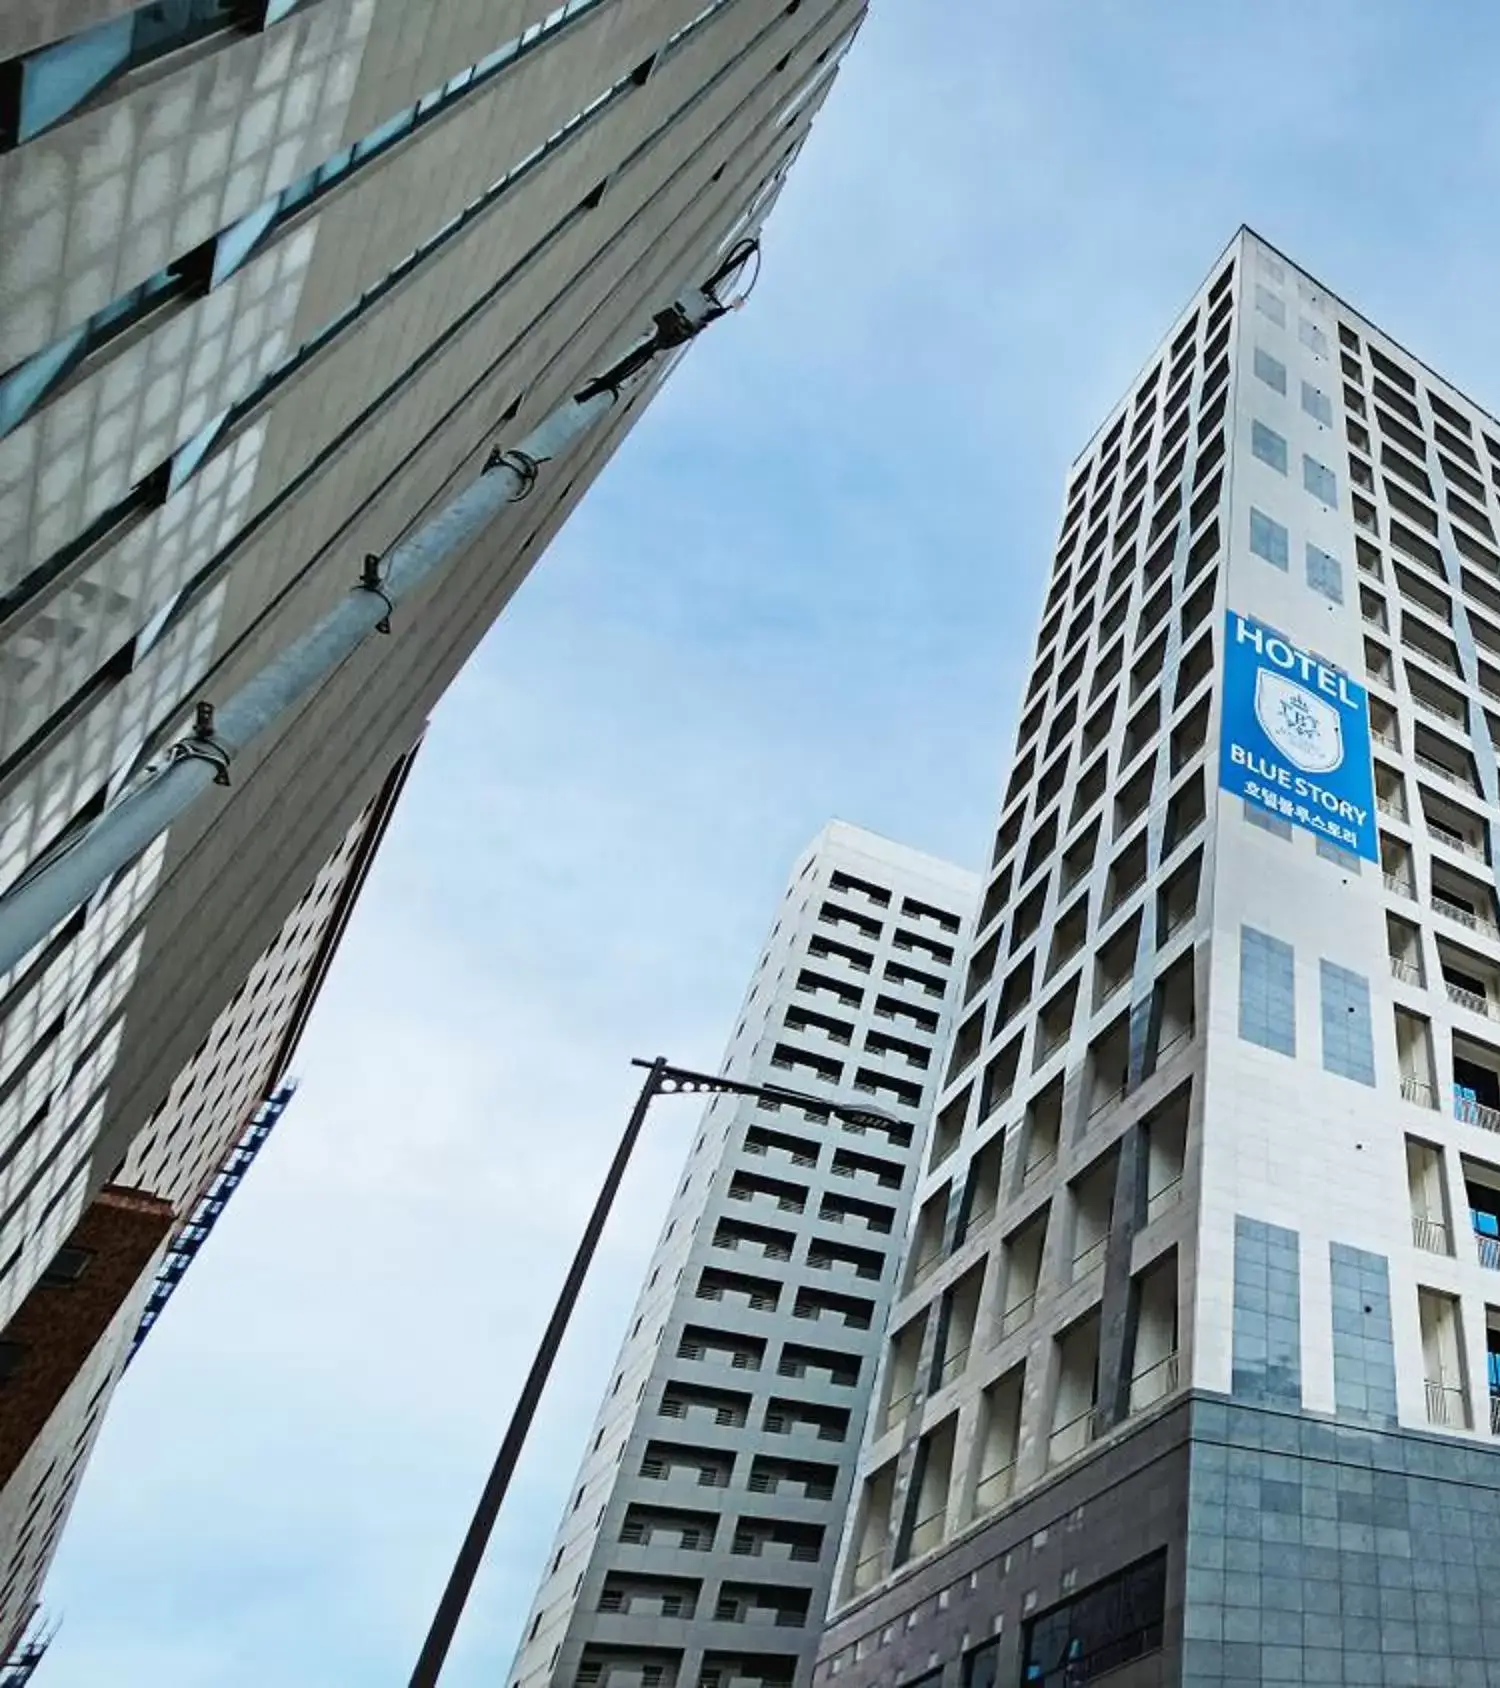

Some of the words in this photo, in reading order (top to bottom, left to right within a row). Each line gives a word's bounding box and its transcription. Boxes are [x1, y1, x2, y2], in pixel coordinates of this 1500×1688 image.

[1236, 618, 1358, 709] HOTEL
[1231, 743, 1291, 788] BLUE
[1295, 777, 1367, 826] STORY
